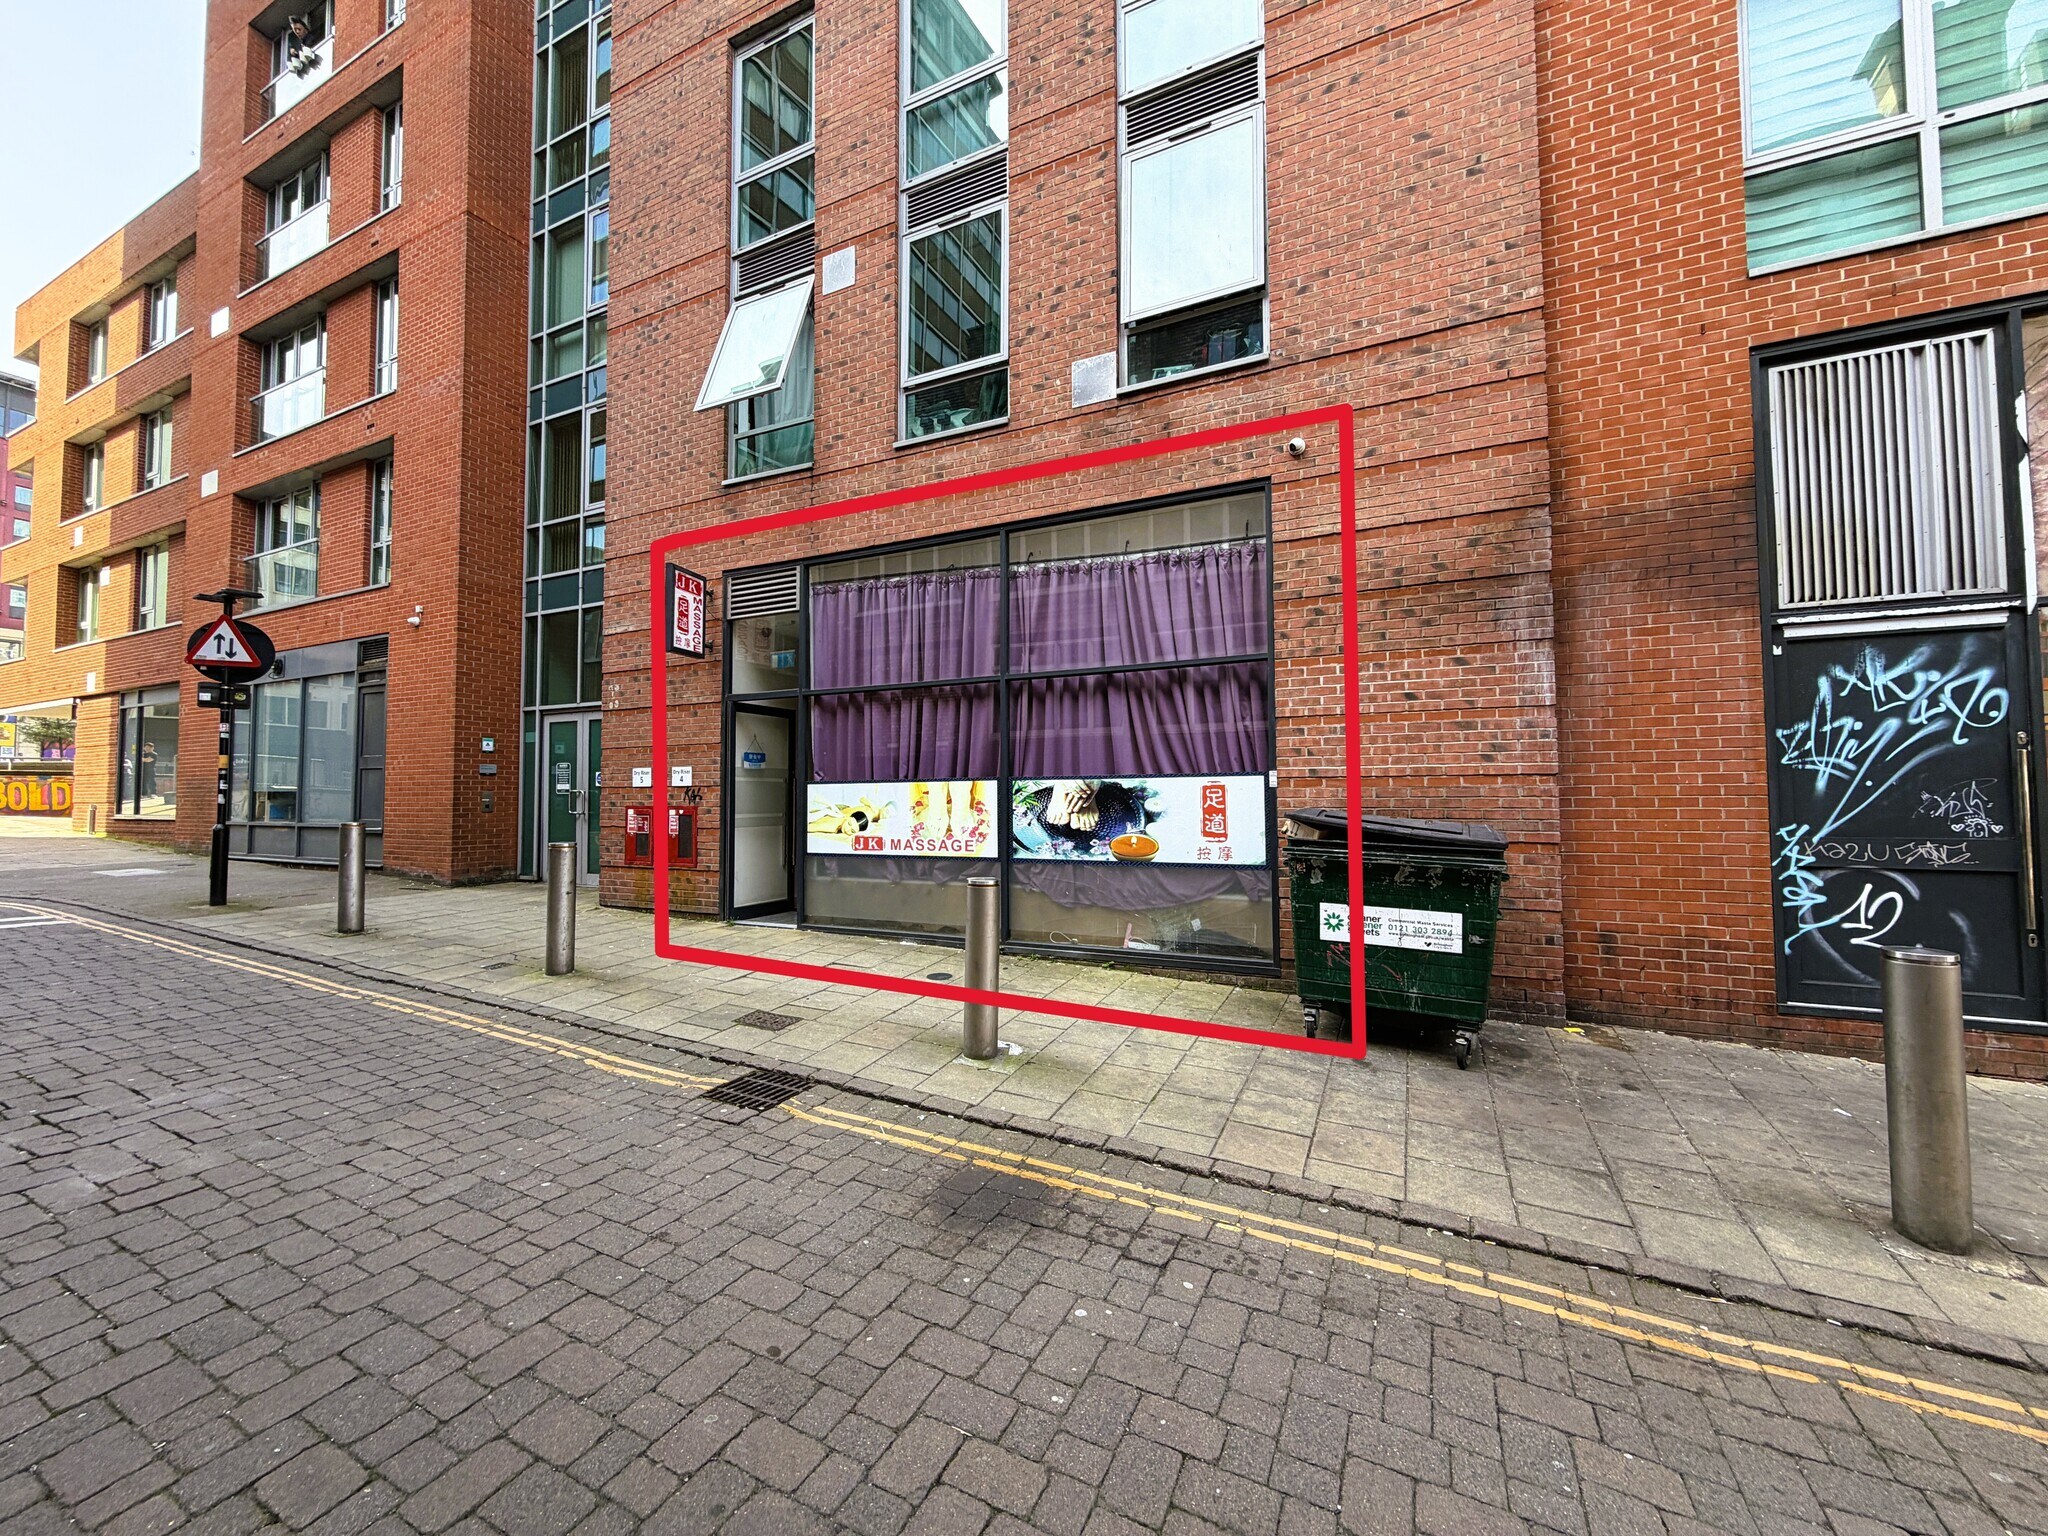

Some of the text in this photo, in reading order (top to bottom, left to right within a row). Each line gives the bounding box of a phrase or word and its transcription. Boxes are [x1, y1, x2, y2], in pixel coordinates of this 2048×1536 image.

[678, 577, 697, 594] JK
[693, 596, 702, 653] MASSAGE
[1204, 788, 1225, 834] 足道
[855, 837, 975, 852] JK MASSAGE
[1197, 846, 1233, 861] 按摩
[1388, 917, 1416, 925] Commercial
[1388, 924, 1408, 932] 0121
[1412, 926, 1428, 935] 303
